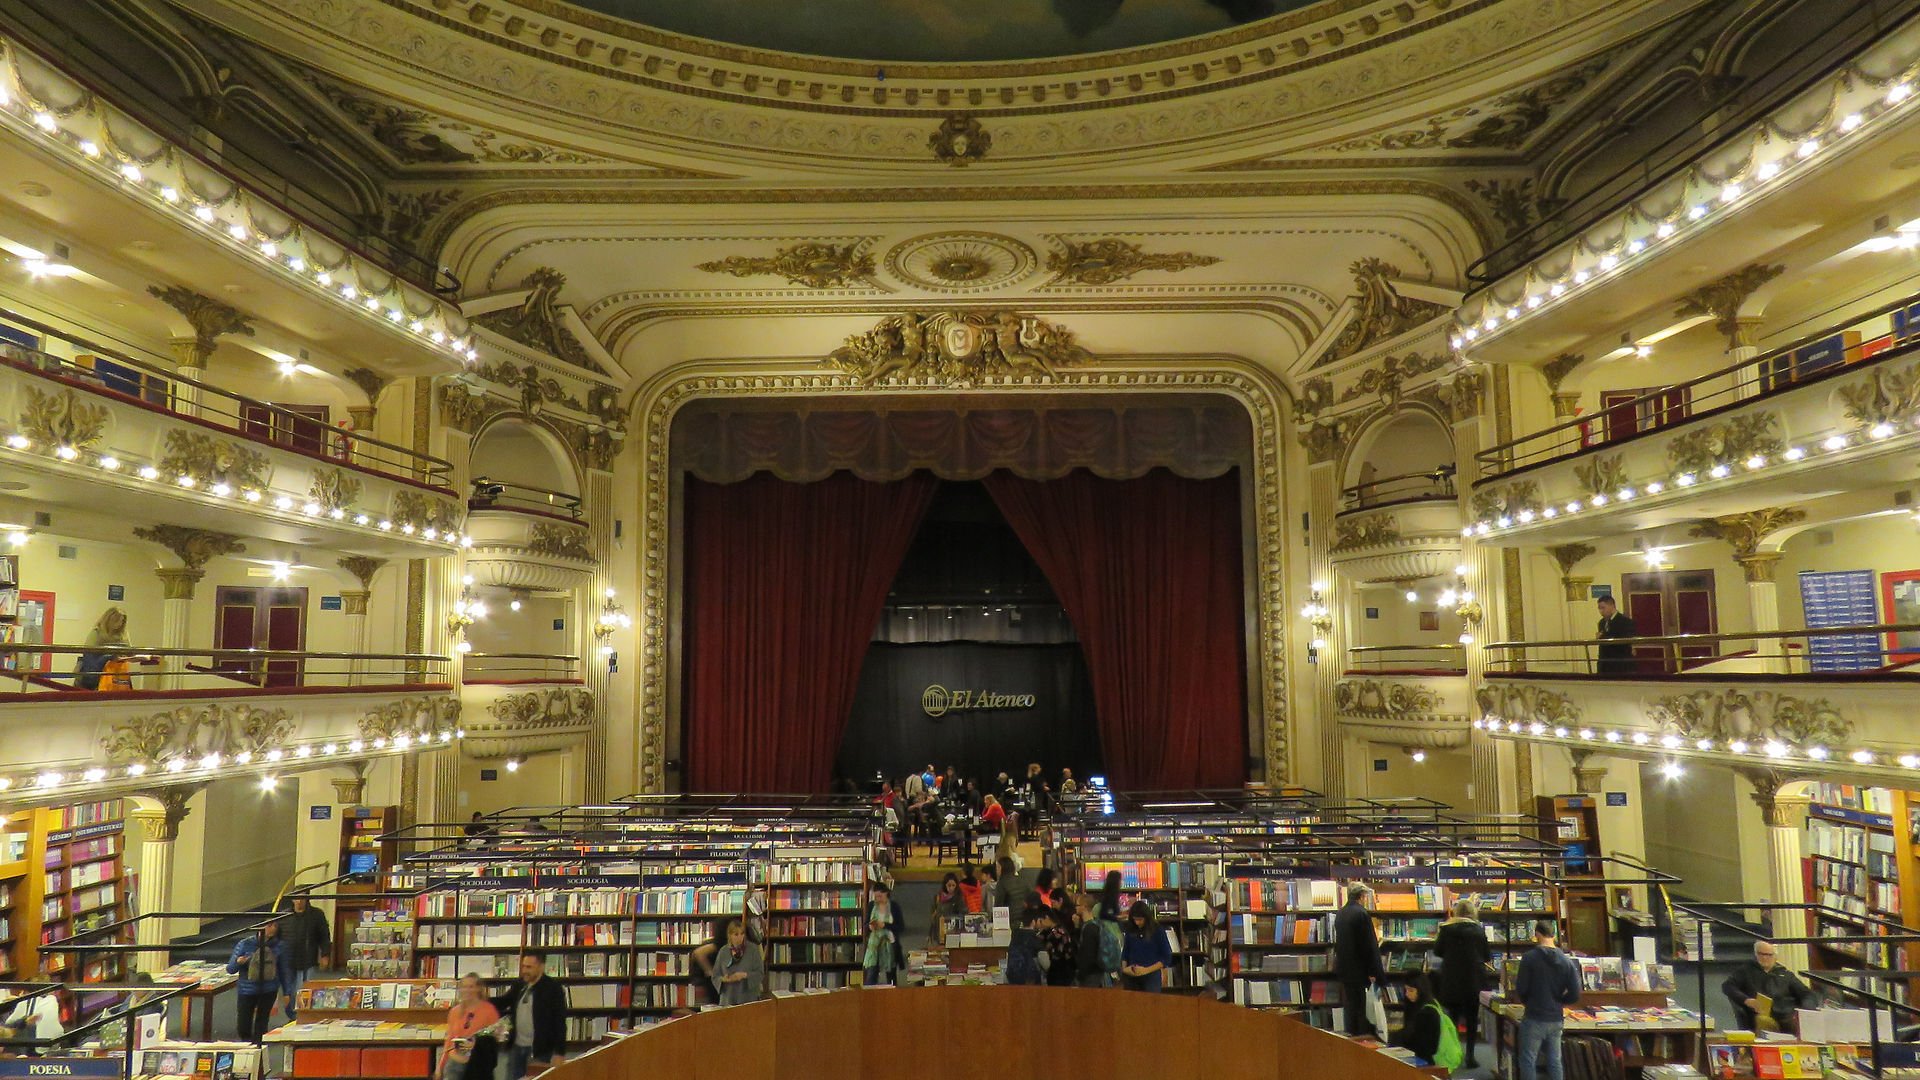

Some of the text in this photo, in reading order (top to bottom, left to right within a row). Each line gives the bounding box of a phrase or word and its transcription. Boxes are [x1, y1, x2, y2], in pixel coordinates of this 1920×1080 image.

[948, 689, 1036, 709] El Ateneo
[29, 1064, 71, 1075] POESIA
